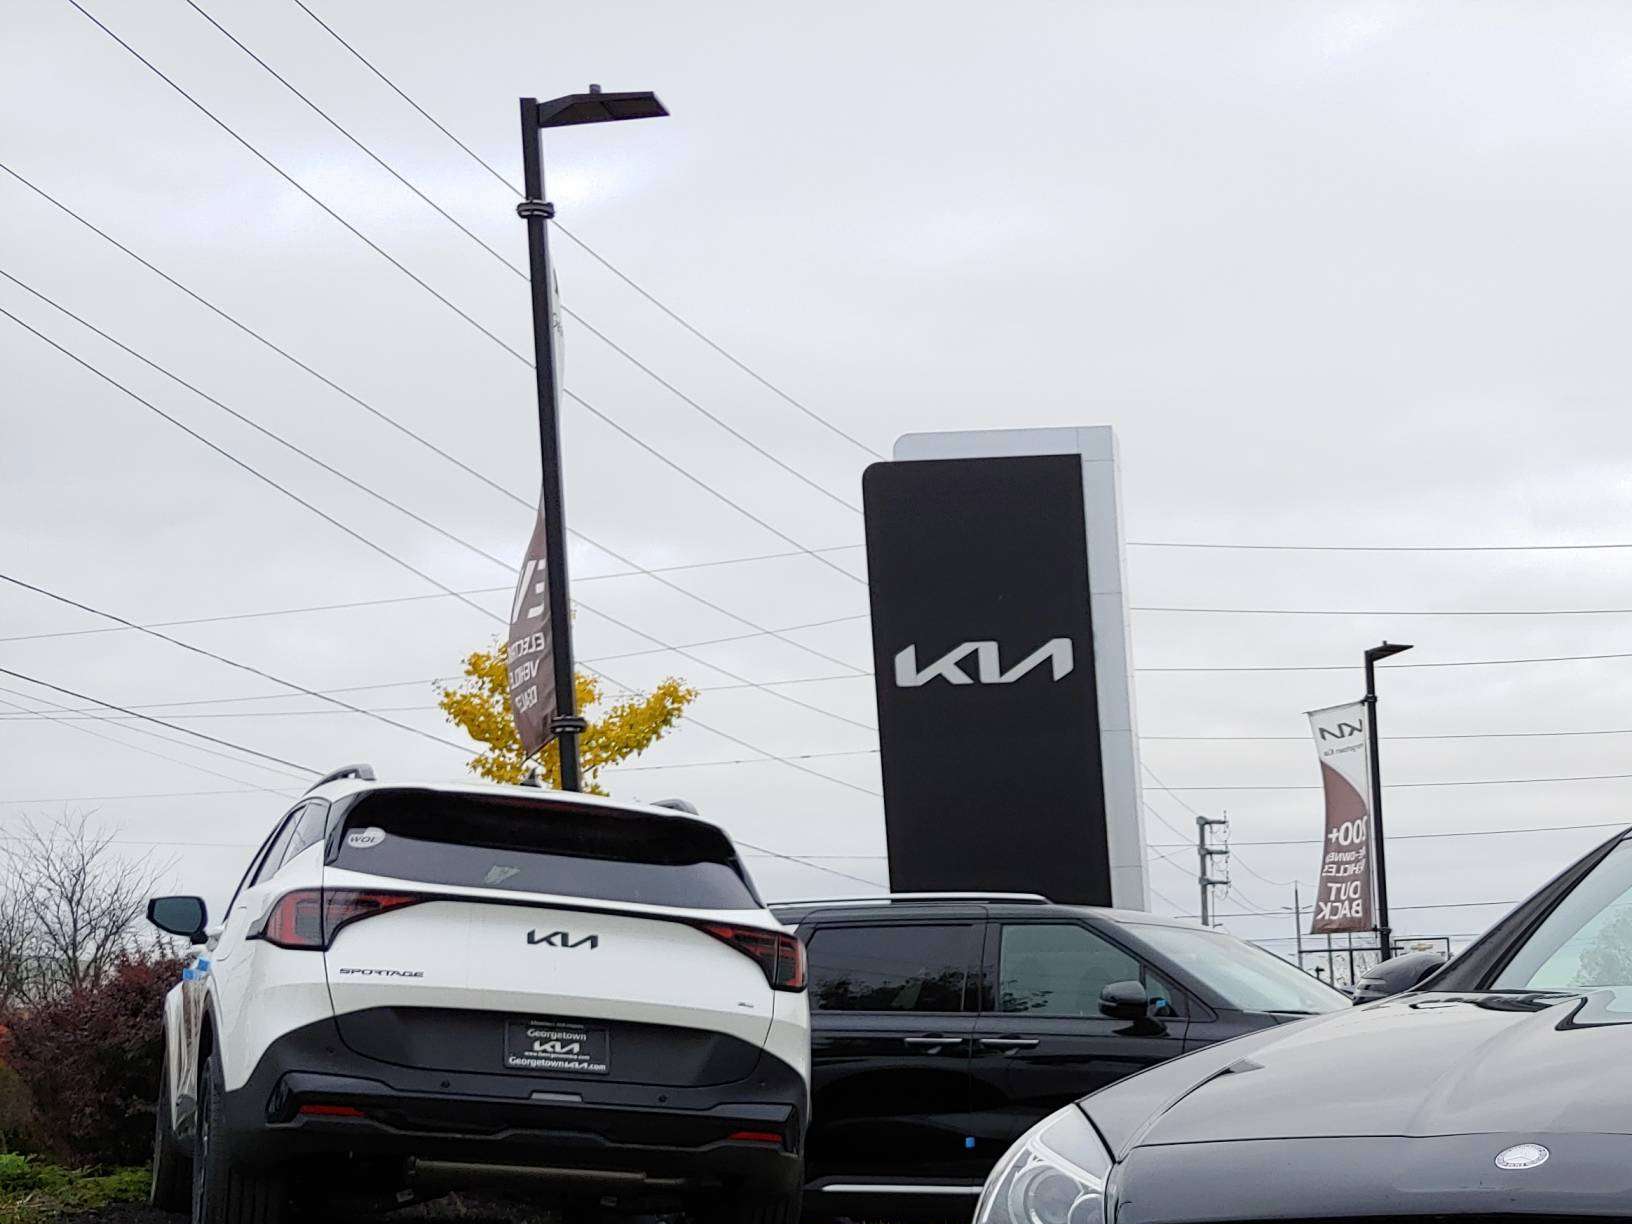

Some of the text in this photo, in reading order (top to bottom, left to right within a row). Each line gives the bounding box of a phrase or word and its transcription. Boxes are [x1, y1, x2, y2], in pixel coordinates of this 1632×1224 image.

[895, 637, 1074, 687] KIA
[527, 928, 598, 950] KIA
[339, 967, 424, 978] SPORTAGE
[527, 1028, 587, 1041] Georgetown
[533, 1040, 580, 1053] KIA
